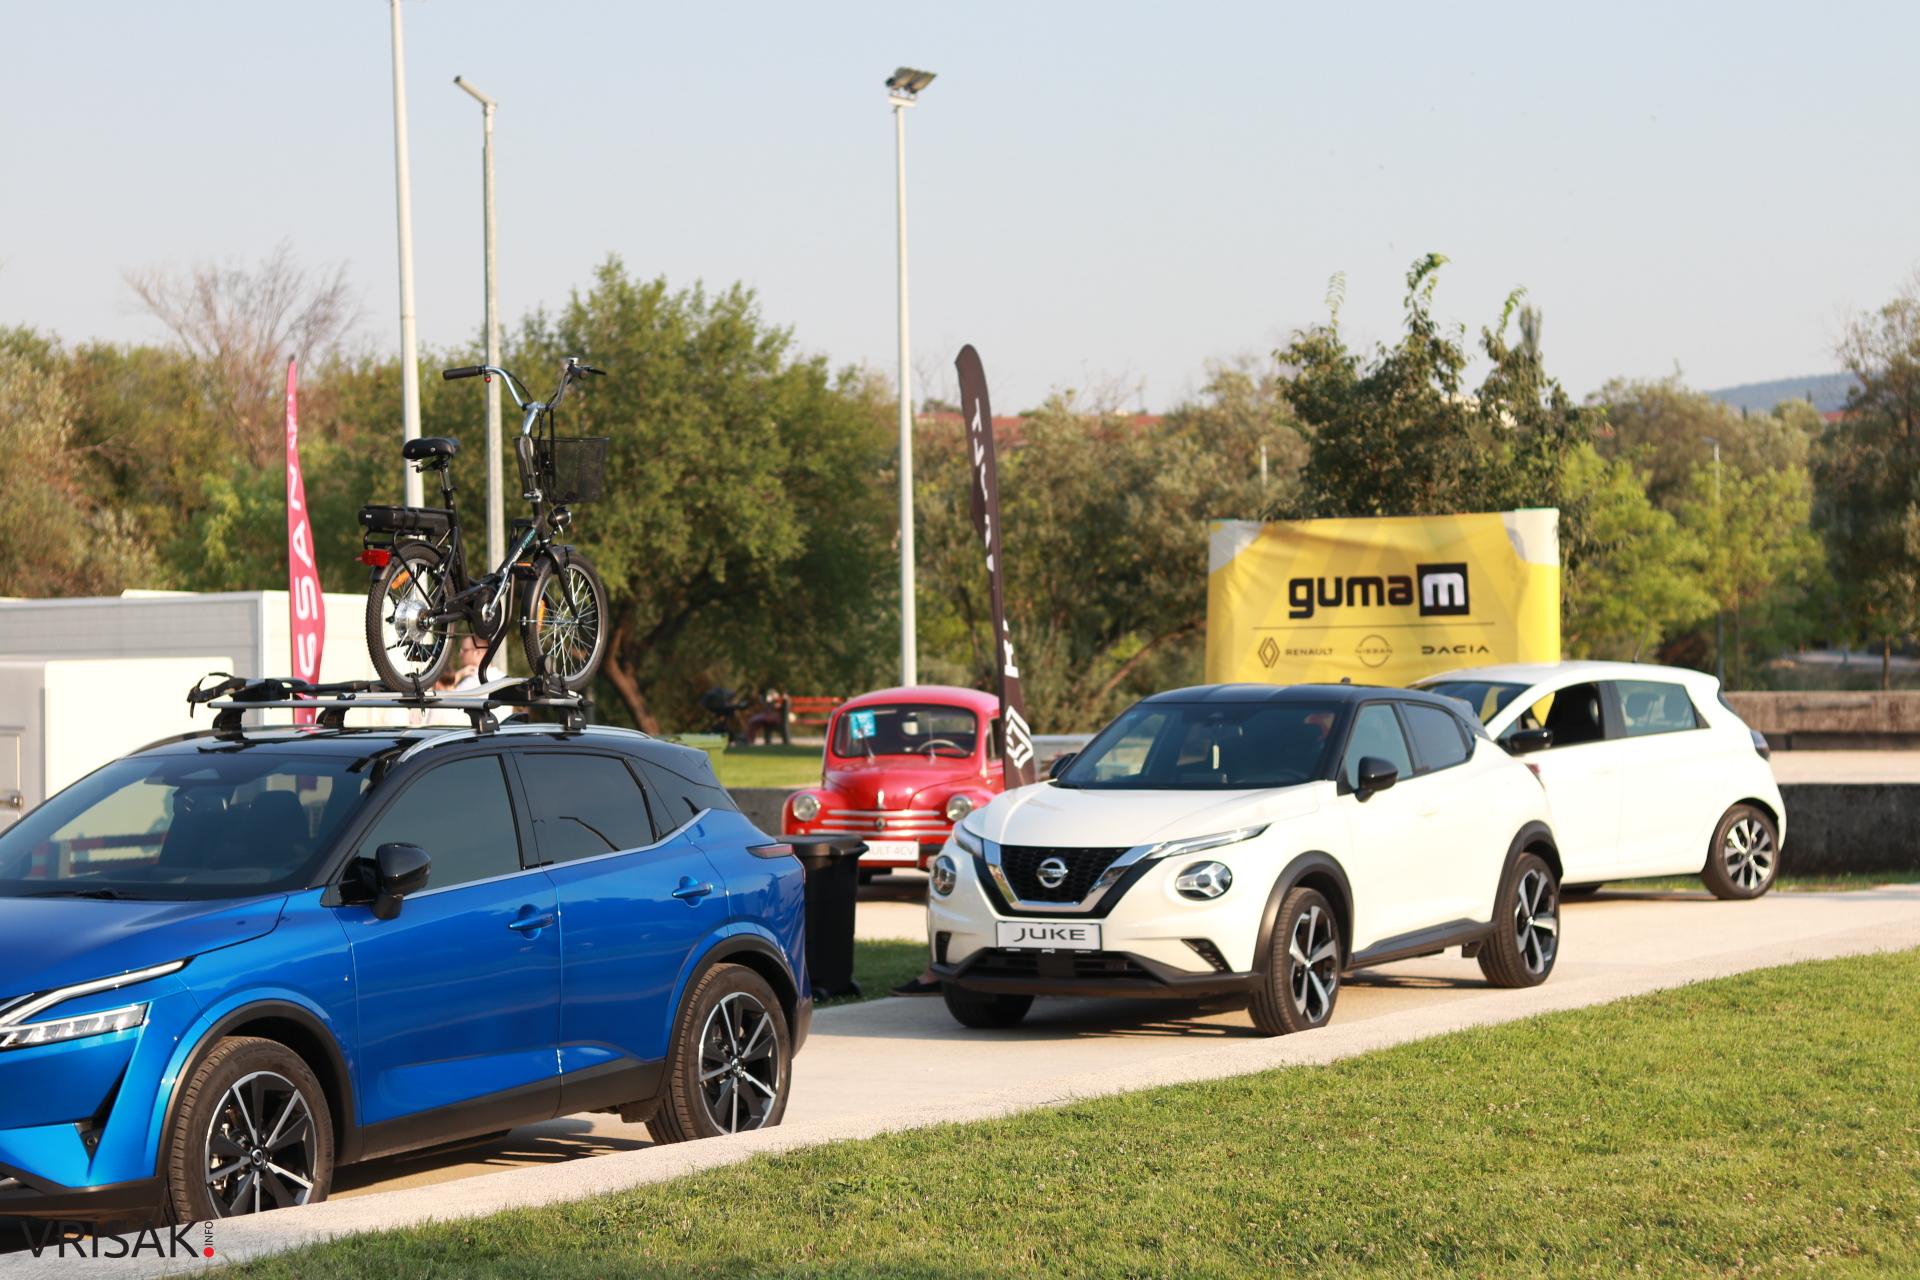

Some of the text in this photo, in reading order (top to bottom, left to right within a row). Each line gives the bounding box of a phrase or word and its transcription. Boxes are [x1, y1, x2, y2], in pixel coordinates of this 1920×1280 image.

[1288, 575, 1413, 619] guma
[1285, 648, 1334, 656] RENAULT
[1421, 644, 1490, 655] DACIA
[1013, 927, 1087, 943] JUKE
